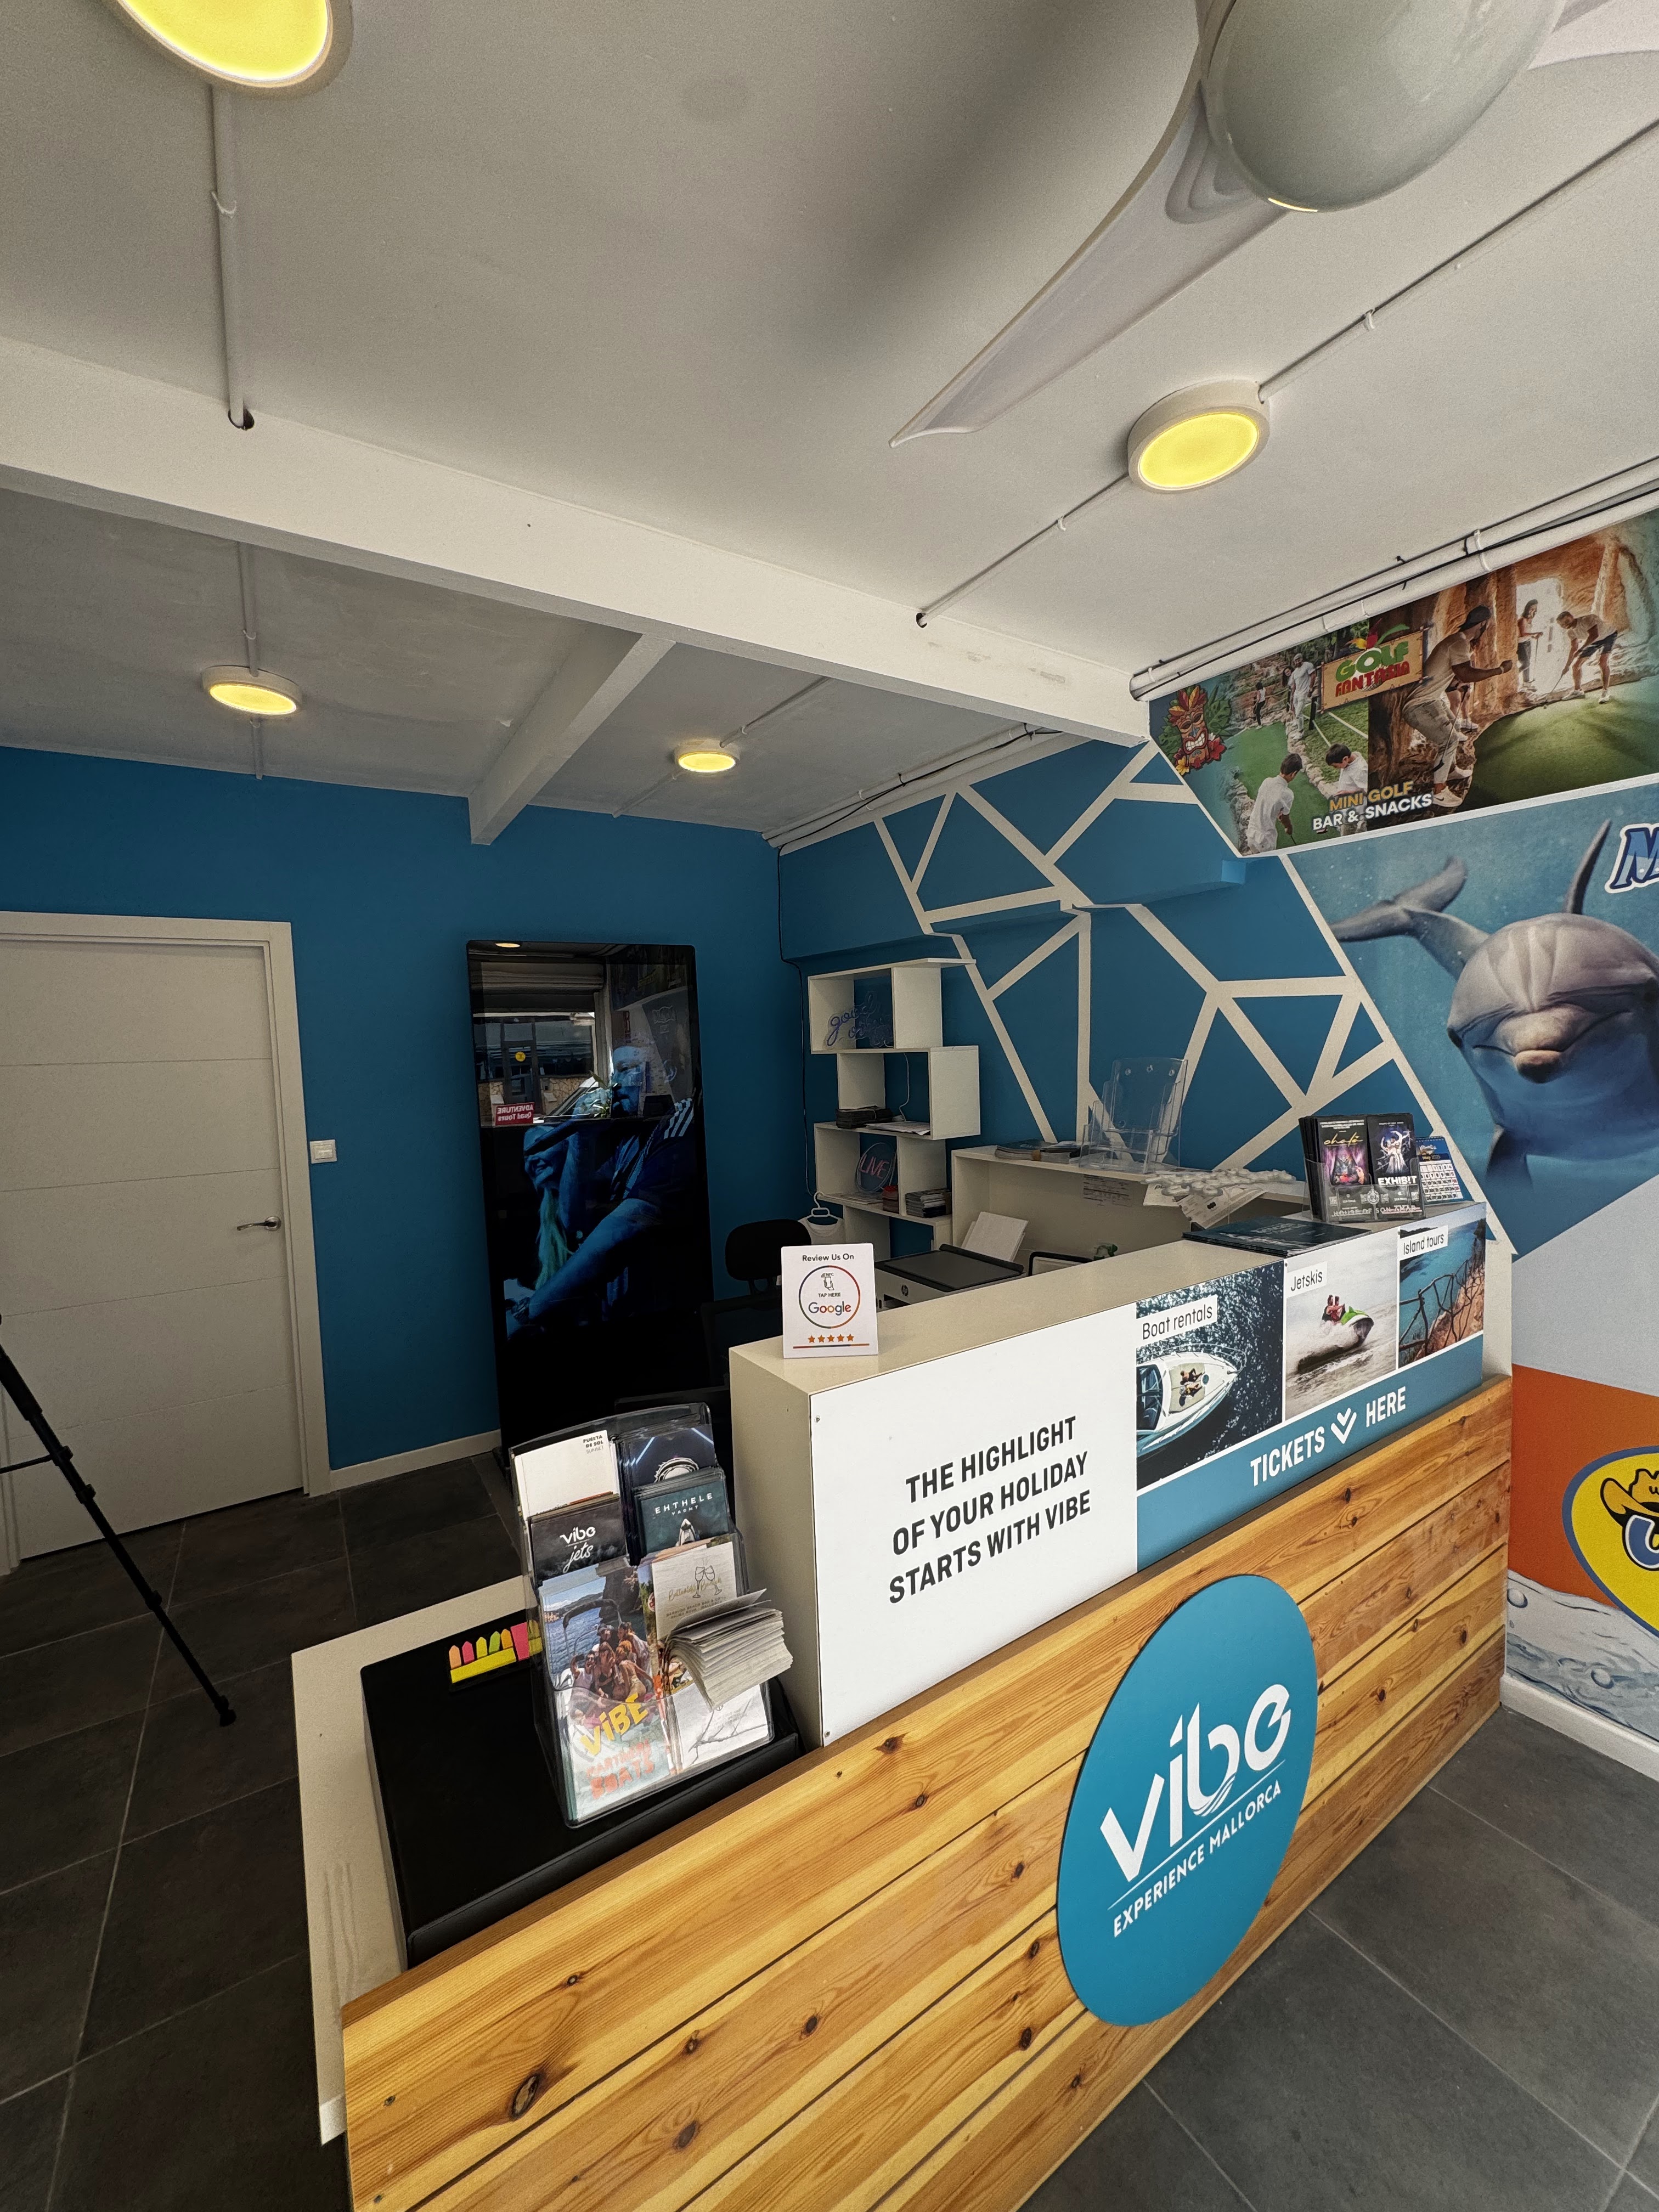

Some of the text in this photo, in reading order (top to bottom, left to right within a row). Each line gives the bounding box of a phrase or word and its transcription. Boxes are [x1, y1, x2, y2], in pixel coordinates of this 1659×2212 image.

[1335, 641, 1409, 682] GOLF
[1335, 661, 1410, 697] FANTASIA
[1312, 793, 1432, 831] BAR & SNACKS
[1329, 781, 1414, 811] MINI GOLF
[859, 1153, 890, 1180] LIVE
[1403, 1233, 1445, 1256] Island tours
[1290, 1269, 1323, 1293] Jetskis
[808, 1301, 851, 1316] Google
[1142, 1305, 1214, 1340] Boat rentals
[1250, 1386, 1407, 1487] TICKETS HERE
[905, 1415, 1076, 1503] THE HIGHLIGHT
[893, 1451, 1088, 1555] OF YOUR HOLIDAY
[560, 1526, 596, 1544] vibe
[889, 1489, 1091, 1604] STARTS WITH VIBE
[563, 1542, 594, 1573] jets
[1099, 1684, 1291, 1882] vibe
[1114, 1780, 1282, 1938] EXPERIENCE MALLORCA
